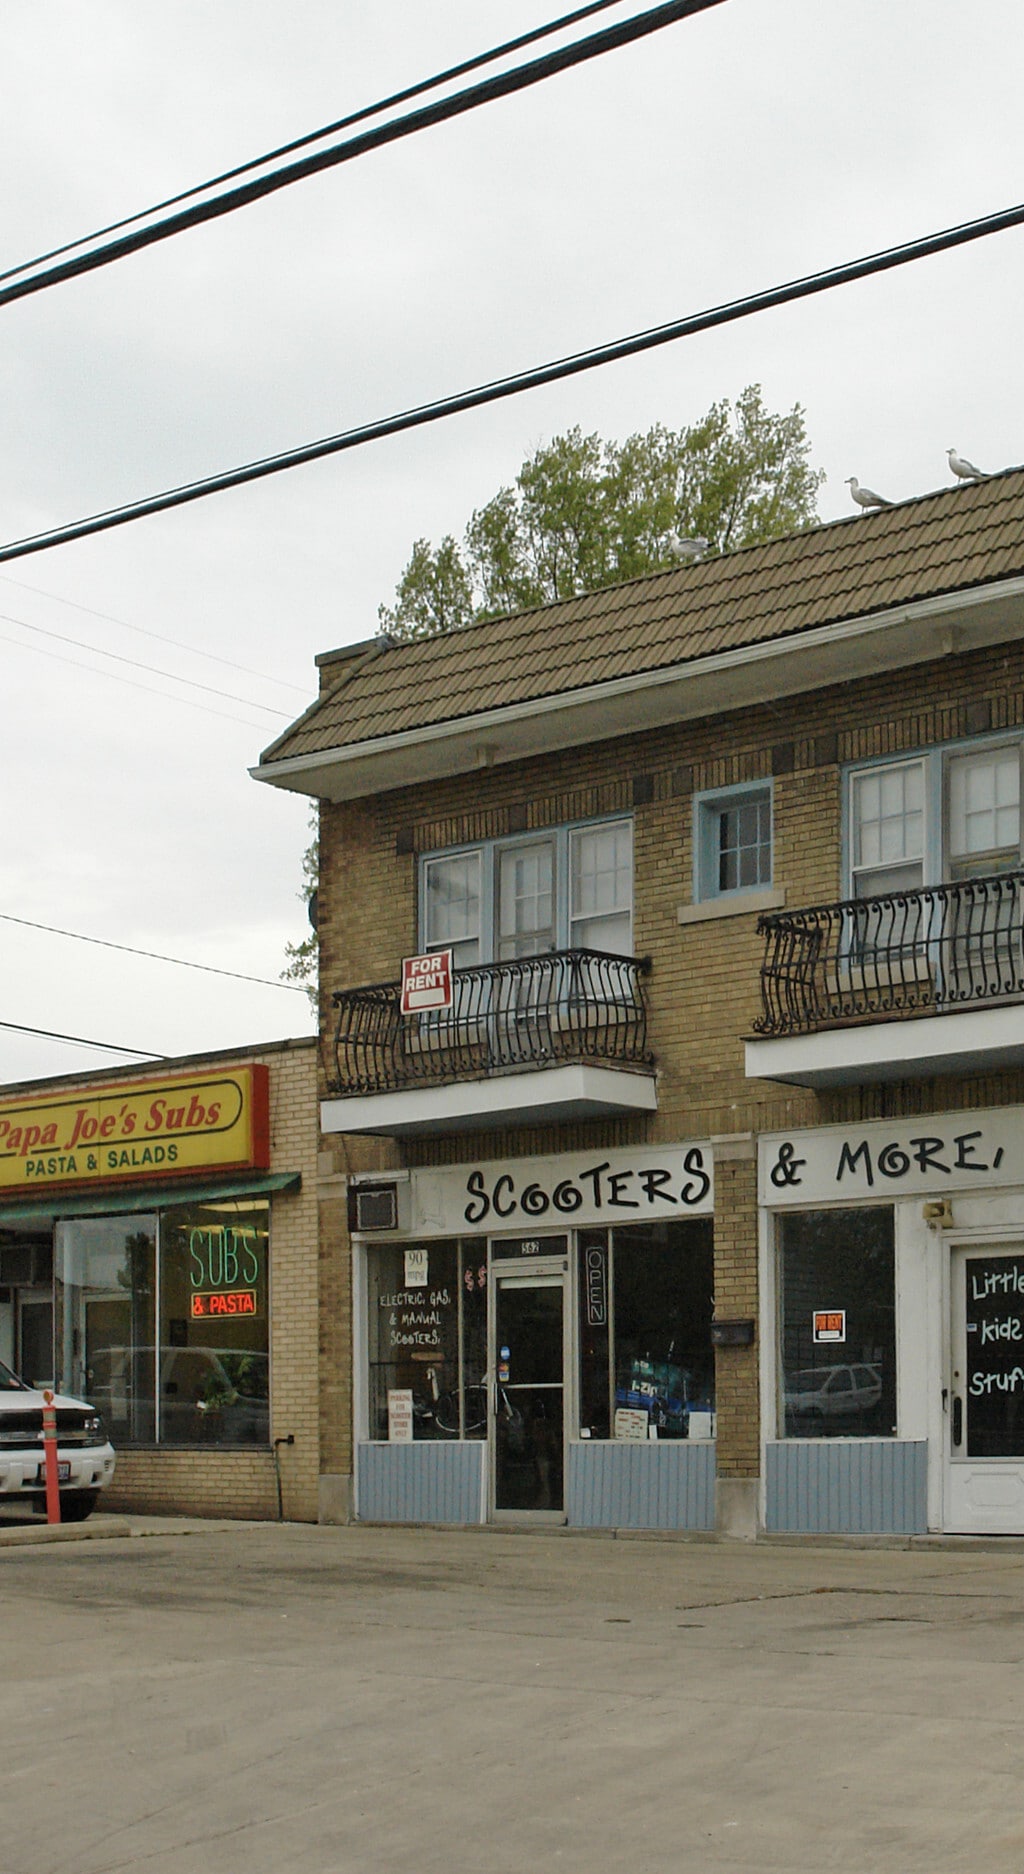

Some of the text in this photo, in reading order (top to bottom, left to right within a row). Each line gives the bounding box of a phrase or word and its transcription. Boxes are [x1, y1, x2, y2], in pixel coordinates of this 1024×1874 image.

[405, 971, 447, 992] RENT
[411, 957, 442, 976] FOR
[64, 1104, 137, 1150] Joe's
[145, 1095, 221, 1132] Subs
[26, 1144, 178, 1177] PASTA & SALADS
[770, 1142, 806, 1188] &
[464, 1148, 711, 1224] SCOOTERS
[190, 1225, 258, 1288] SUBS
[193, 1293, 254, 1315] & PASTA
[588, 1251, 603, 1321] OPEN
